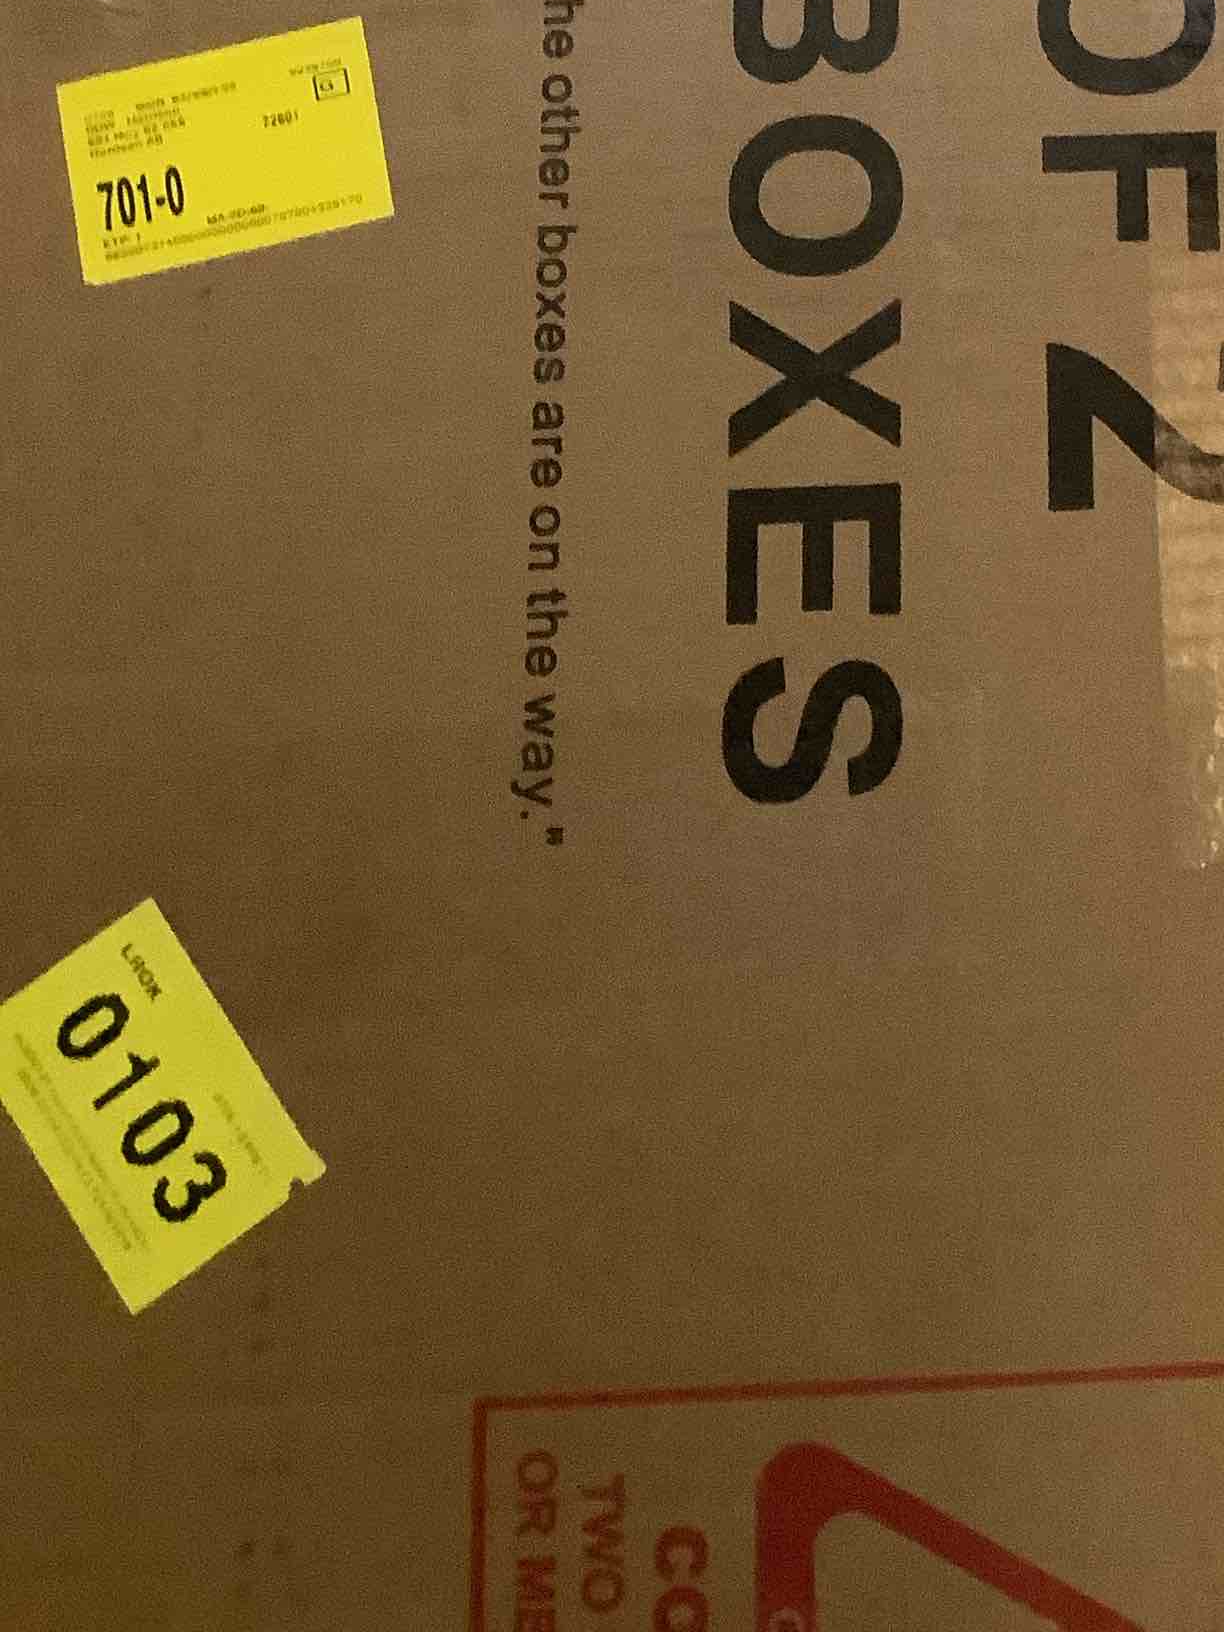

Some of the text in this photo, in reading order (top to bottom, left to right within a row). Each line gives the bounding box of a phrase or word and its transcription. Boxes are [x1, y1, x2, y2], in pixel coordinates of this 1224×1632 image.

[536, 72, 583, 210] other
[95, 164, 186, 231] 701-0
[532, 224, 577, 386] boxes
[528, 399, 564, 490] are
[526, 503, 561, 573] on
[523, 588, 569, 679] the
[57, 993, 228, 1224] 0103
[518, 1449, 559, 1534] OR
[582, 1473, 625, 1615] TWO
